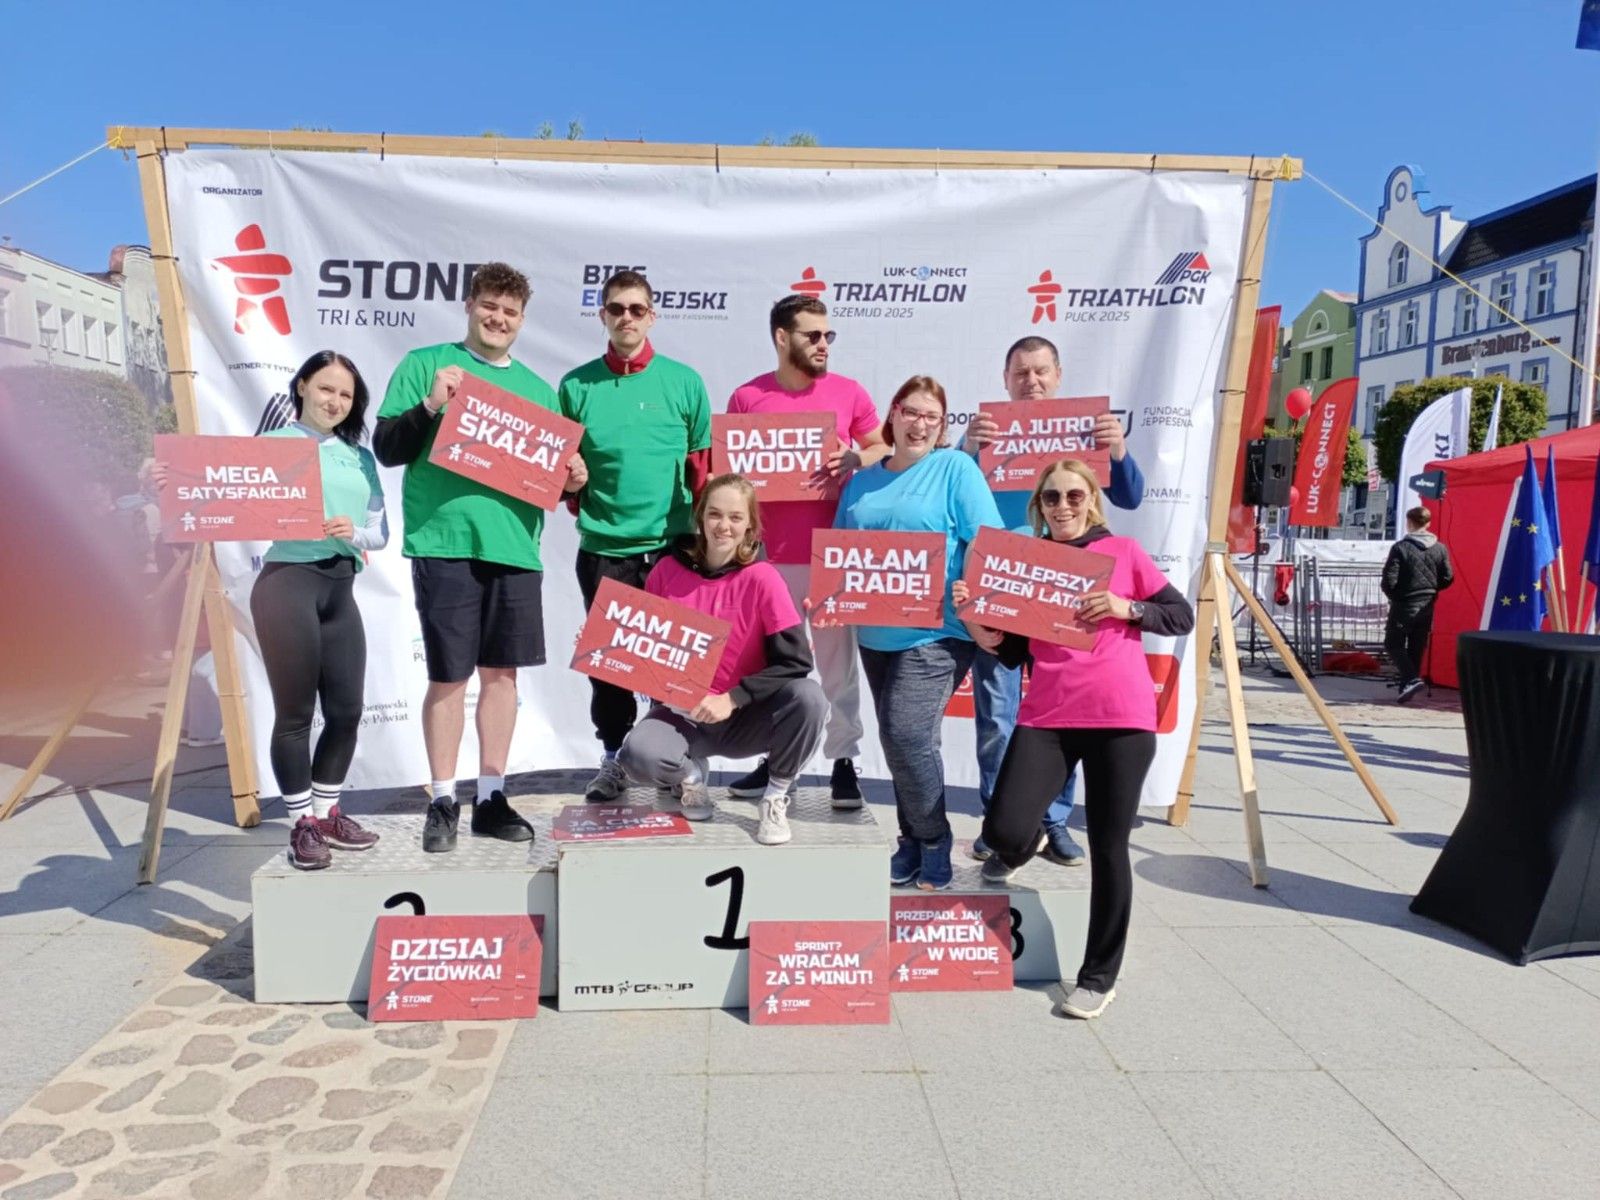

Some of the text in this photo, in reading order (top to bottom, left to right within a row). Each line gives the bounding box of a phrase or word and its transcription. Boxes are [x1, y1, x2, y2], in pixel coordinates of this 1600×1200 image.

[202, 186, 263, 196] ORGANIZATOR
[1180, 269, 1211, 284] PGK
[581, 289, 728, 310] EPEJSKI
[832, 283, 967, 302] TRIATHLON
[1067, 286, 1205, 307] TRIATHLON
[317, 308, 415, 327] TRI & RUN
[831, 307, 914, 318] SZEMUD 2025
[1065, 311, 1130, 322] PUCK 2025
[1143, 407, 1192, 417] FUNDACJA
[466, 395, 567, 450] TWARDY JAK
[1028, 416, 1095, 435] JUTRO
[1140, 417, 1194, 428] JEPPESENA
[456, 412, 560, 472] SKAŁA!
[726, 427, 823, 450] DAJCIE
[992, 436, 1096, 455] ZAKWASY!
[464, 452, 494, 470] STONE
[727, 450, 822, 473] WODY!
[205, 466, 279, 484] MEGA
[1008, 468, 1035, 476] STONE
[177, 486, 307, 500] SATYSFAKCJA!
[200, 515, 235, 525] STONE
[824, 547, 928, 571] DAŁAM
[984, 555, 1095, 593] NAJLEPSZY
[845, 571, 931, 600] RADĘ!
[979, 573, 1034, 598] DZIEŃ
[839, 602, 868, 610] STONE
[989, 603, 1019, 617] STONE
[605, 600, 713, 659] MAM TĘ
[610, 627, 690, 672] MOC!!!
[604, 658, 634, 673] STONE
[372, 713, 409, 724] Powiat
[704, 865, 750, 950] 1
[895, 910, 983, 921] PRZEPADŁ JAK
[896, 920, 985, 943] KAMIEŃ
[390, 937, 504, 961] DZISIAJ
[794, 941, 843, 952] SPRINT?
[927, 946, 999, 964] W WODĘ
[778, 953, 860, 969] WRACAM
[387, 962, 502, 982] ŻYCIÓWKA!
[765, 970, 873, 986] ZA 5 MINUT!
[912, 968, 939, 976] STONE
[402, 994, 433, 1004] STONE
[574, 985, 614, 995] MTB
[781, 999, 811, 1008] STONE
